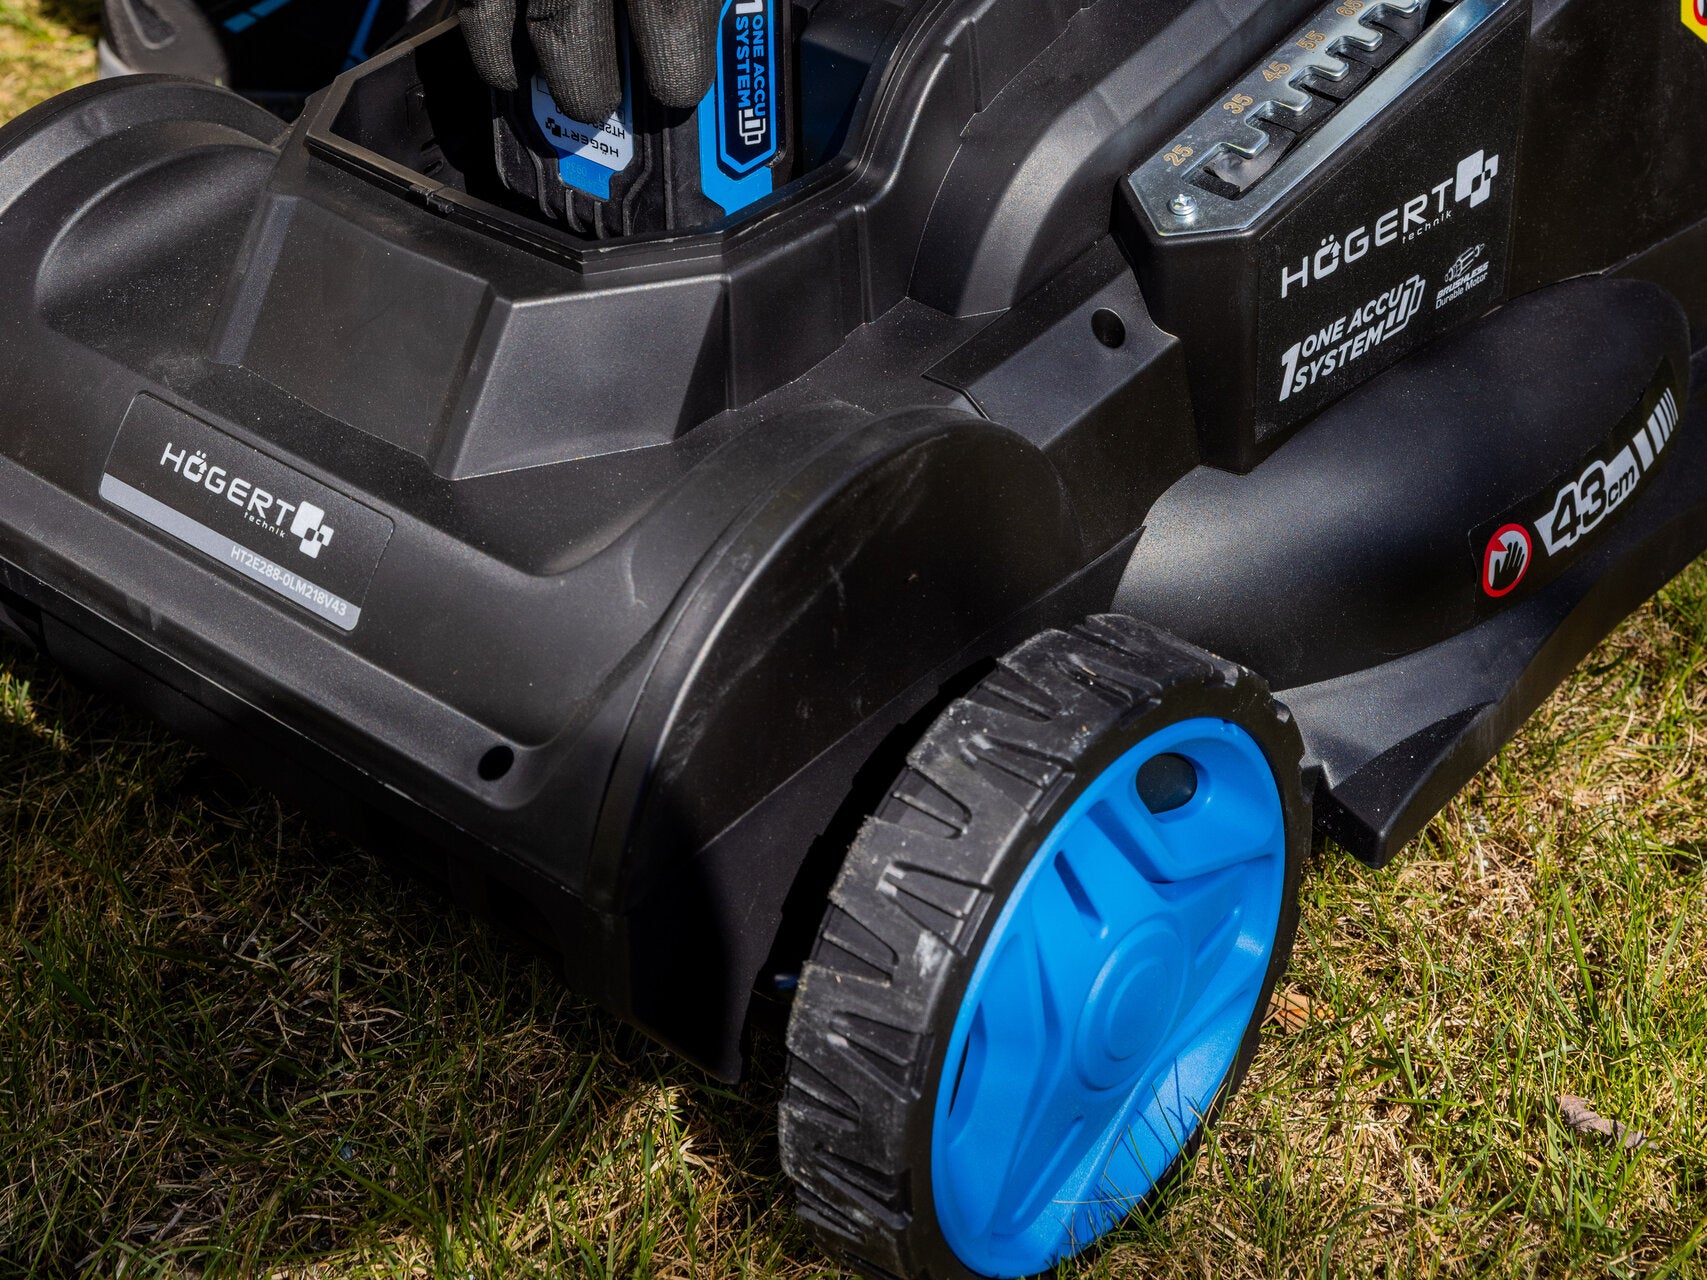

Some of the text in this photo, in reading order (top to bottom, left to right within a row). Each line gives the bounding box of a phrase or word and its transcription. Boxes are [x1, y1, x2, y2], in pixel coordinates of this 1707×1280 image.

[1296, 30, 1327, 51] 55
[735, 15, 751, 111] SYSTEM
[751, 14, 767, 118] ONE ACCU
[1260, 60, 1292, 83] 45
[1222, 93, 1254, 115] 35
[561, 127, 619, 158] HÖGERT
[1163, 144, 1194, 168] 25
[1281, 177, 1454, 299] HÖGERT
[1402, 209, 1452, 245] technik
[1435, 272, 1488, 310] Durable Motor
[1301, 282, 1402, 358] ONE ACCU
[1292, 321, 1387, 394] SYSTEM
[160, 442, 297, 526] HÖGERT
[244, 511, 287, 539] technik
